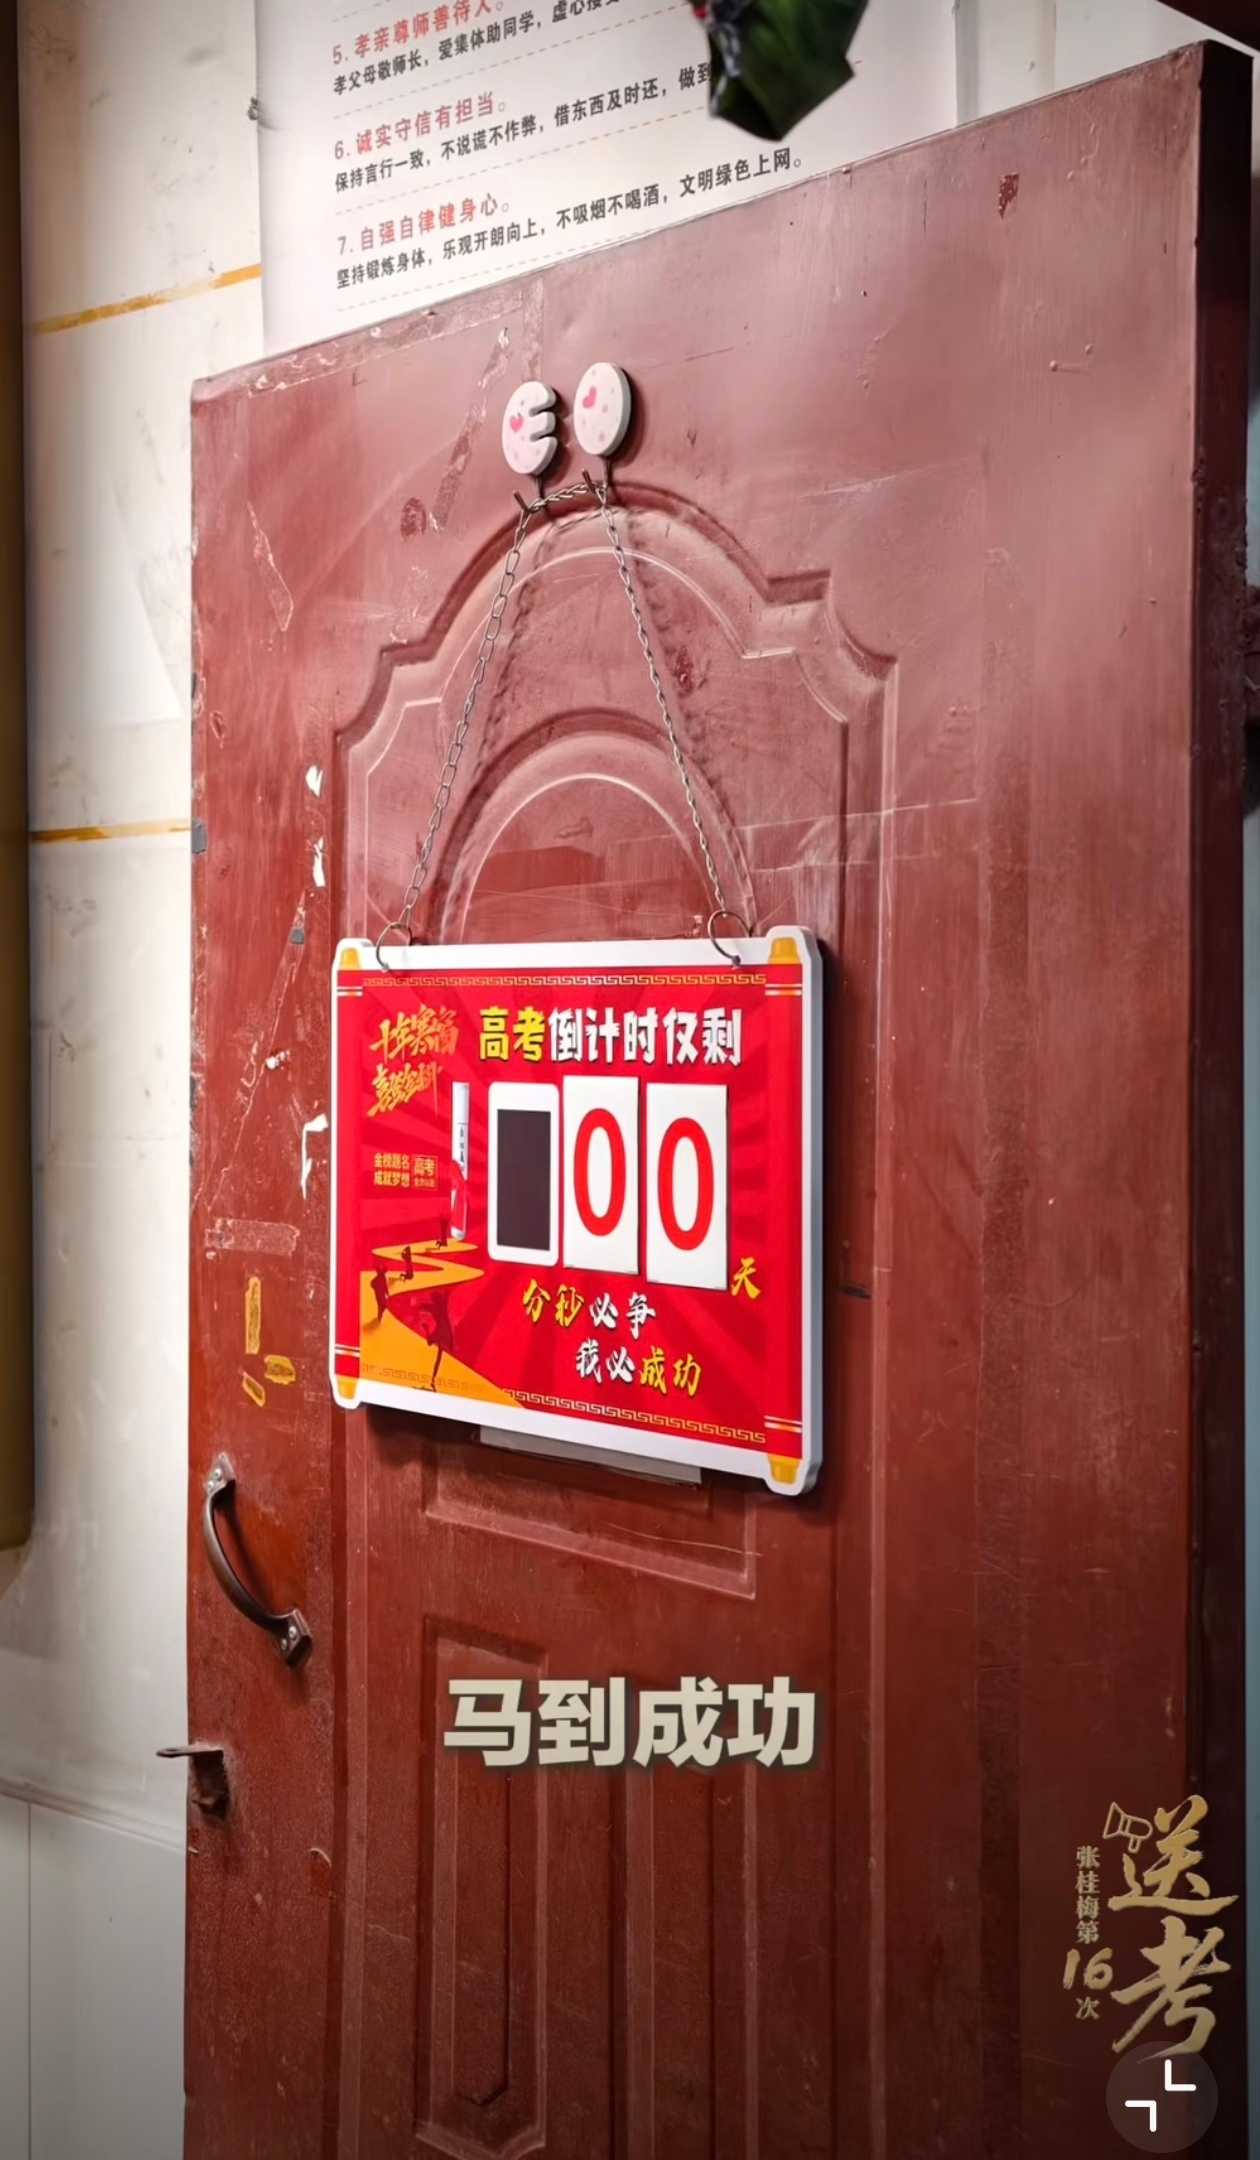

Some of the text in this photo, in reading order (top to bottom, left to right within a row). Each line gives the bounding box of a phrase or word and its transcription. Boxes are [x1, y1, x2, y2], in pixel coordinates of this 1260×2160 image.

[333, 0, 619, 96] 孝父母敬师长，爱集体助同学，虚心接
[334, 91, 506, 160] 6.诚实守信有担当。
[337, 192, 510, 257] 7.自强自律健身心。
[478, 1006, 743, 1067] 高考倒计时仅剩
[731, 1257, 761, 1299] 天
[522, 1279, 656, 1340] 分秒必争
[575, 1337, 702, 1397] 我必成功
